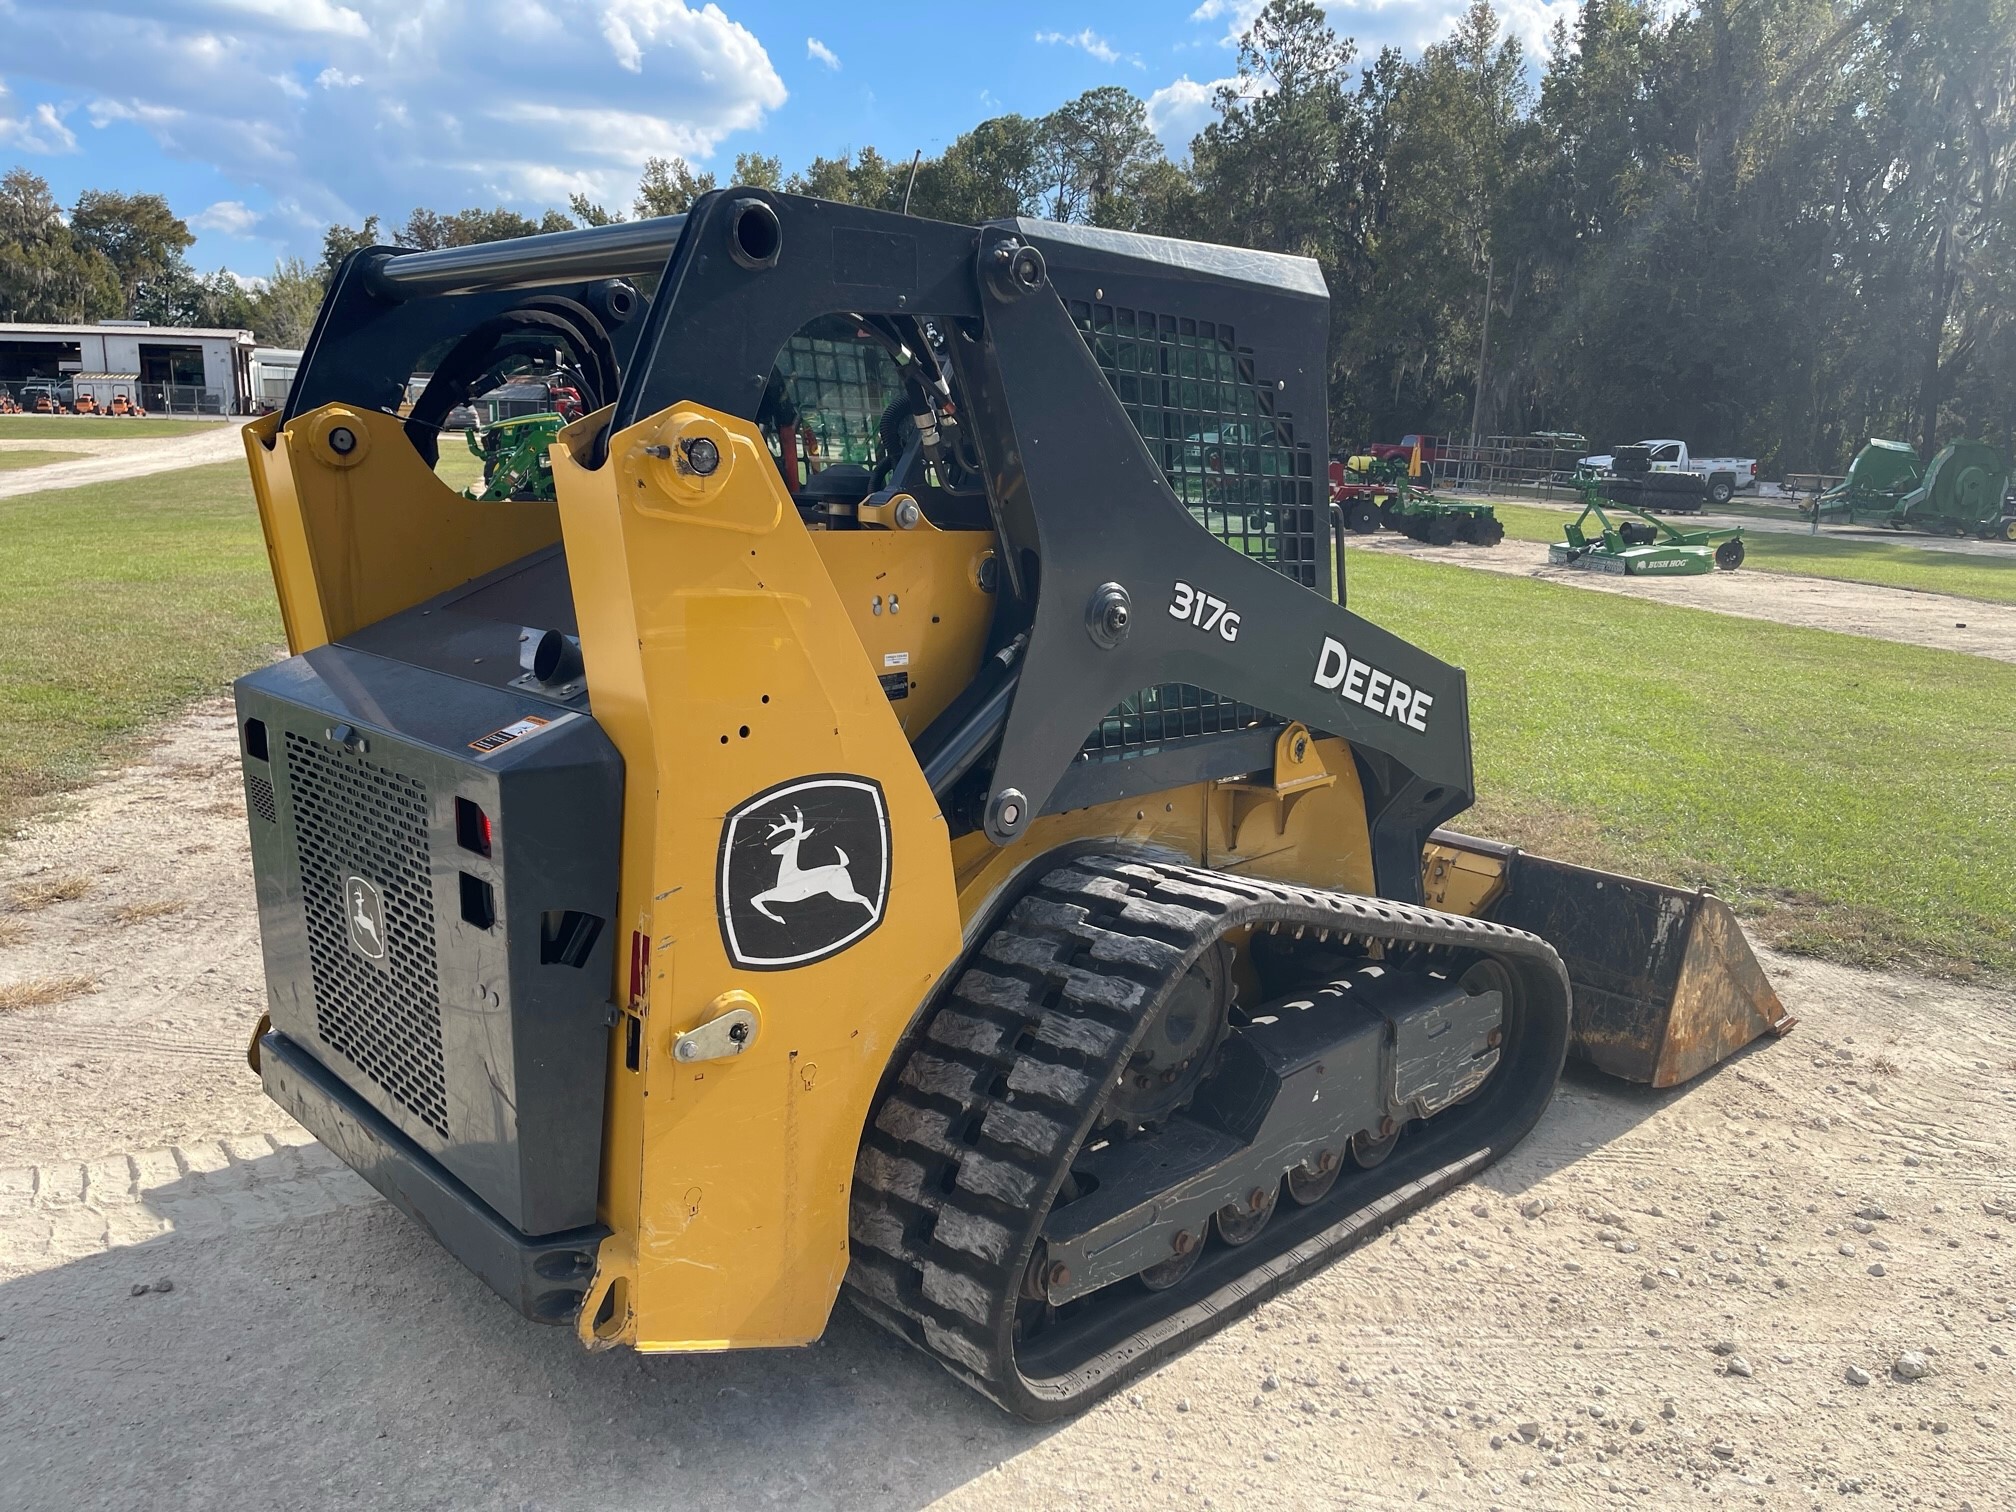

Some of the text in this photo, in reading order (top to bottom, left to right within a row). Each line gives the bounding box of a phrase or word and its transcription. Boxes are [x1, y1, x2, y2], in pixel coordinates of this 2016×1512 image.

[1648, 559, 1687, 569] BUSH HOG
[1168, 582, 1241, 642] 317G
[1313, 636, 1434, 732] DEERE
